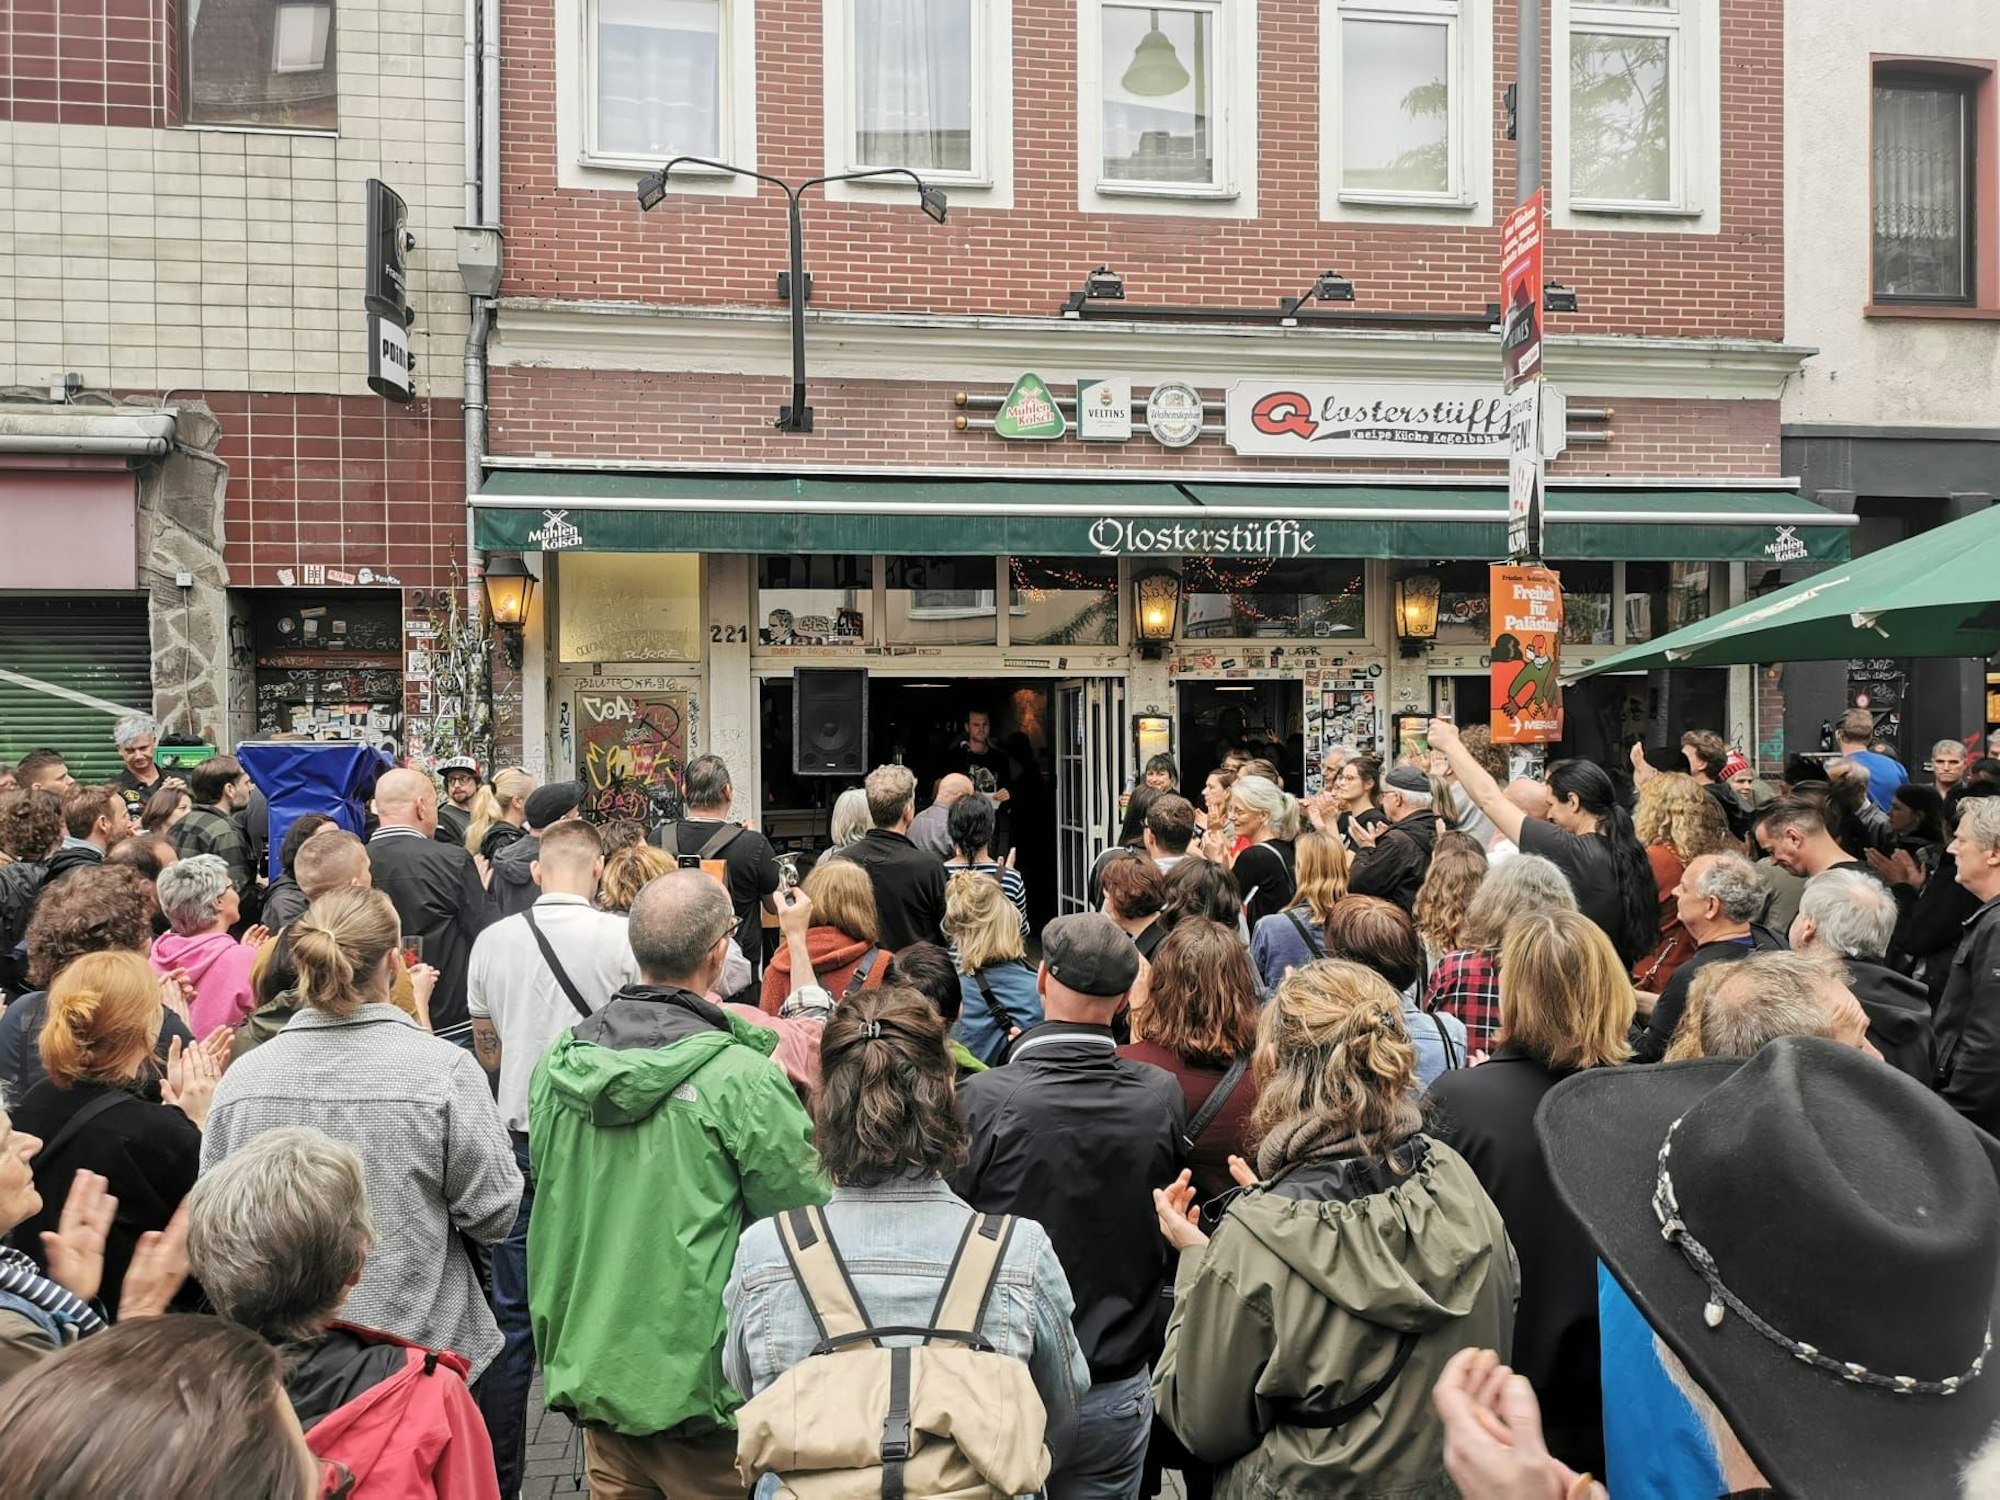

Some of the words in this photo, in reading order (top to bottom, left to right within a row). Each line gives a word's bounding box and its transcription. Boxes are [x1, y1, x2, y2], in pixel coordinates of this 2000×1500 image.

[1088, 408, 1126, 420] VELTINS
[1251, 391, 1512, 440] Qlosterstüffj
[1350, 428, 1392, 440] Kneipe
[1394, 430, 1430, 443] Küche
[1432, 431, 1500, 445] Kegelbahn
[528, 525, 578, 543] Mühlen
[1088, 516, 1317, 558] Qlosterstüffje
[541, 536, 583, 551] Kölsch
[1764, 540, 1804, 555] Mühlen
[1775, 549, 1808, 562] Kölsch
[1530, 600, 1548, 616] für
[710, 625, 748, 643] 221
